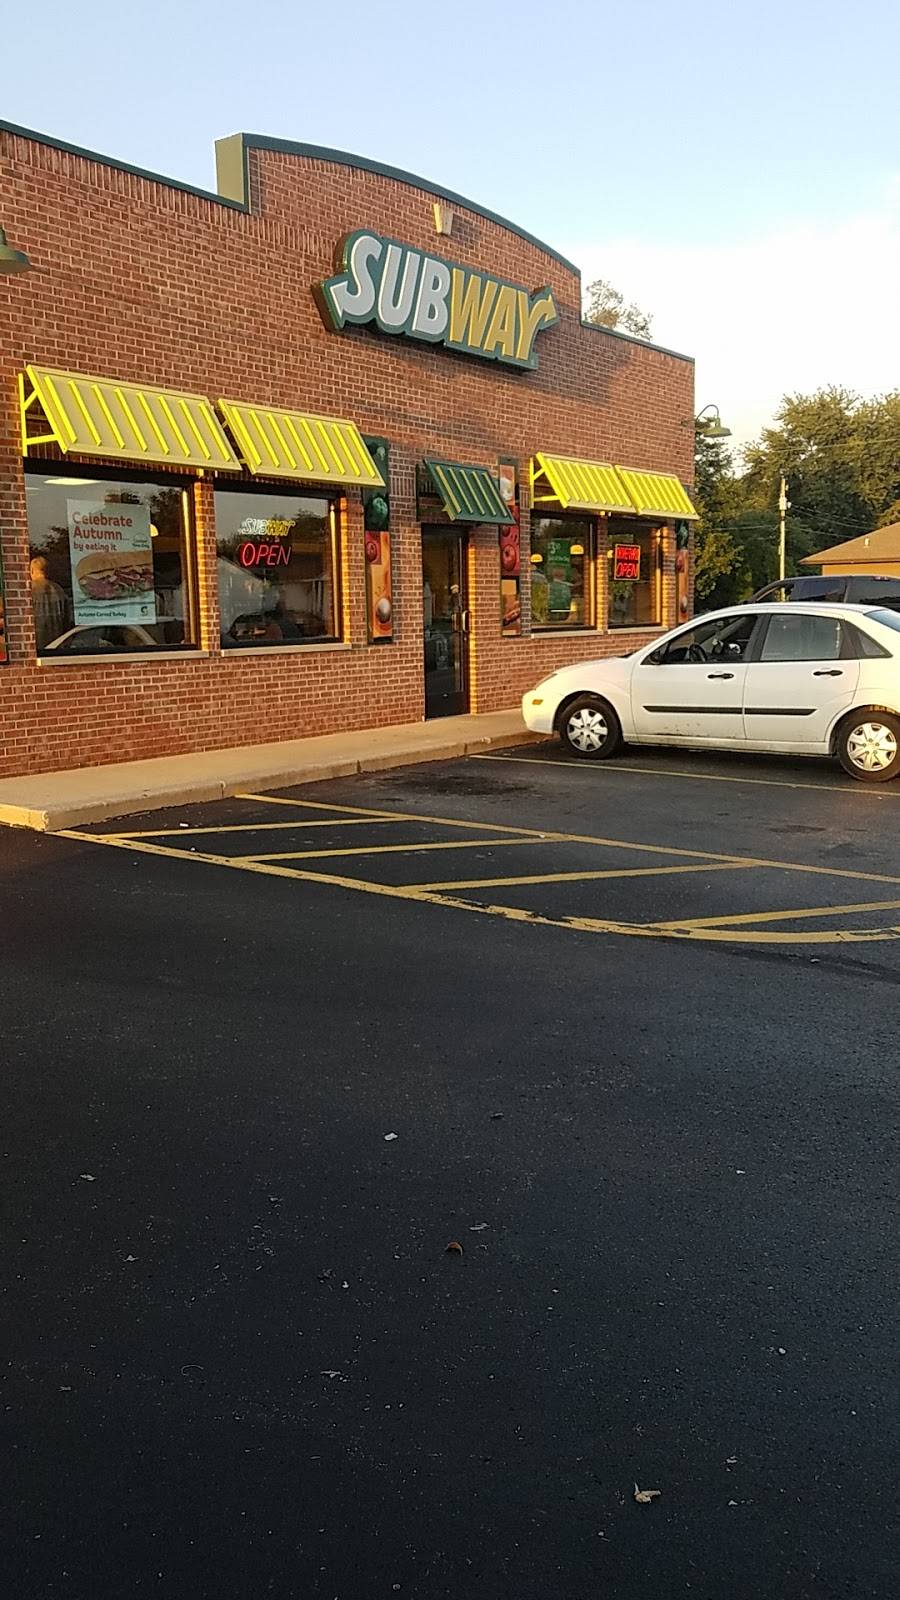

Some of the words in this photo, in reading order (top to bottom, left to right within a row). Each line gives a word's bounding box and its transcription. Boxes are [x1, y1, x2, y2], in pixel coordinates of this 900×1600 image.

[329, 235, 557, 360] SUBWAY
[72, 511, 133, 527] Celebrate
[238, 518, 296, 536] SUBWAY
[73, 542, 84, 551] by
[86, 543, 110, 553] eating
[242, 543, 292, 566] OPEN
[616, 562, 638, 577] OPEN
